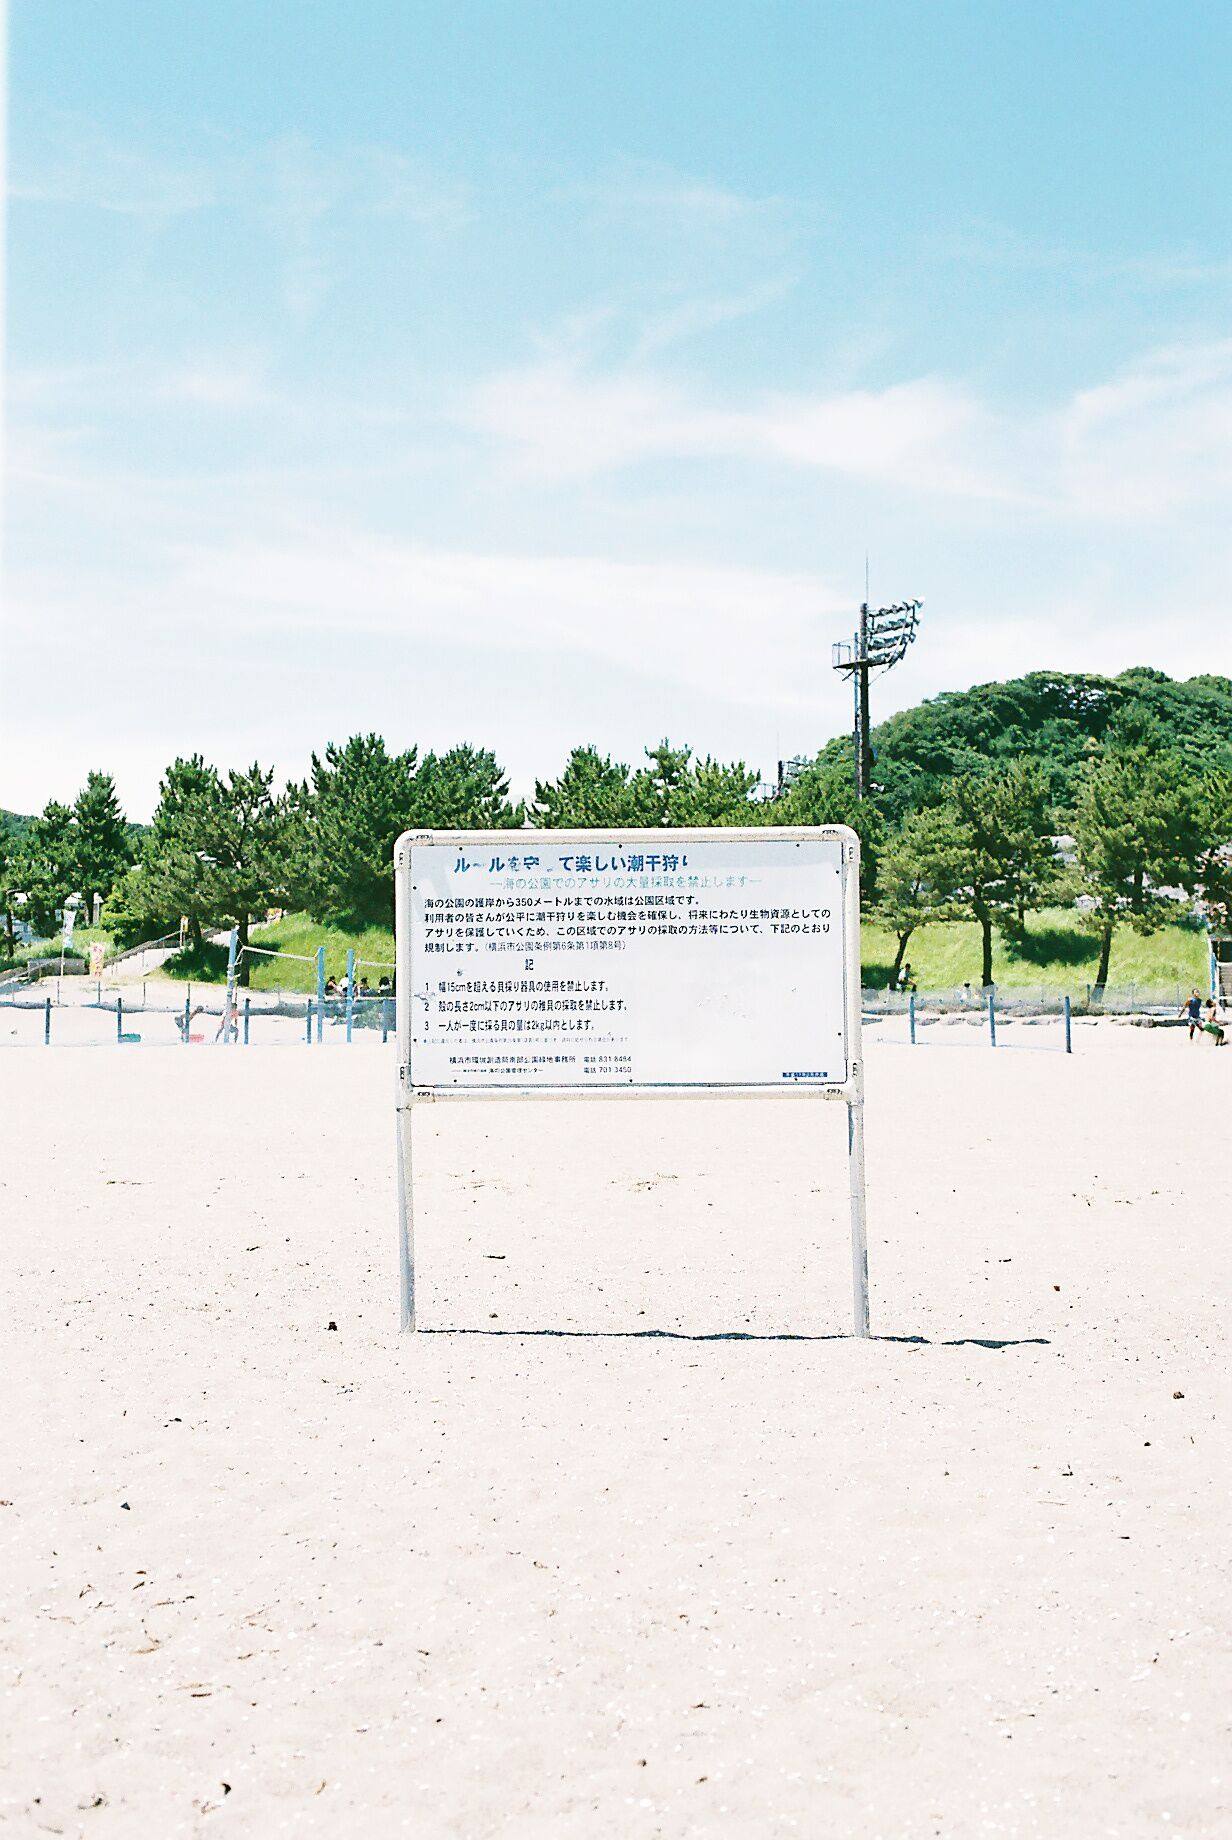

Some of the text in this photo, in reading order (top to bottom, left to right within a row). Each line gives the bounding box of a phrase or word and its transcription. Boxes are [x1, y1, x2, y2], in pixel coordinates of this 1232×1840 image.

[424, 895, 699, 909] 海の公園の護岸から350メートルまでの水域は公園区域です。
[424, 908, 831, 923] 利用者の皆さんが公平に潮干狩りを楽しむ機会を確保し、将来にわたり生物資源としての
[425, 923, 830, 938] アサリを保護していくため、この区域でのアサリの採取の方法等について、下記のとおり
[524, 958, 535, 971] 記
[424, 982, 430, 992] 1
[423, 1001, 430, 1012] 2
[424, 1020, 430, 1031] 3
